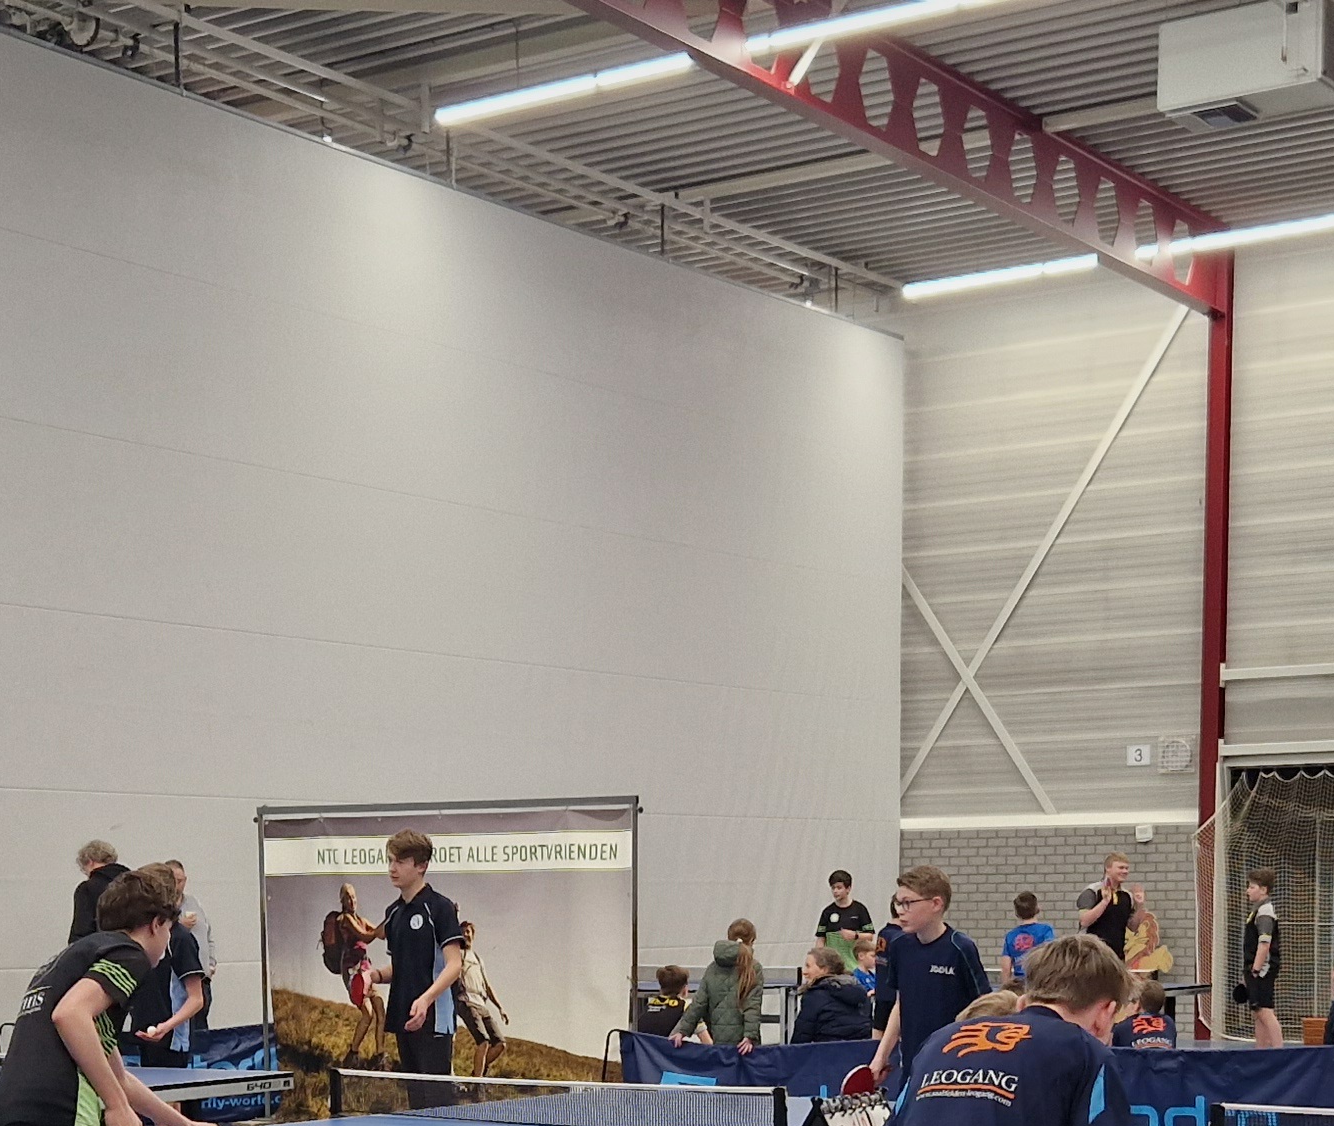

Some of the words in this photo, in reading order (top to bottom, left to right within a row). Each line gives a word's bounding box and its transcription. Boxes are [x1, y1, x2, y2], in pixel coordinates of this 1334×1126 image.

[1134, 748, 1143, 763] 3
[317, 848, 339, 864] NTC
[343, 847, 389, 864] LEOGA
[430, 846, 463, 863] ROET
[466, 845, 498, 862] ALLE
[502, 842, 618, 861] SPORTVRIENDEN
[920, 1068, 1019, 1092] LEOGANG
